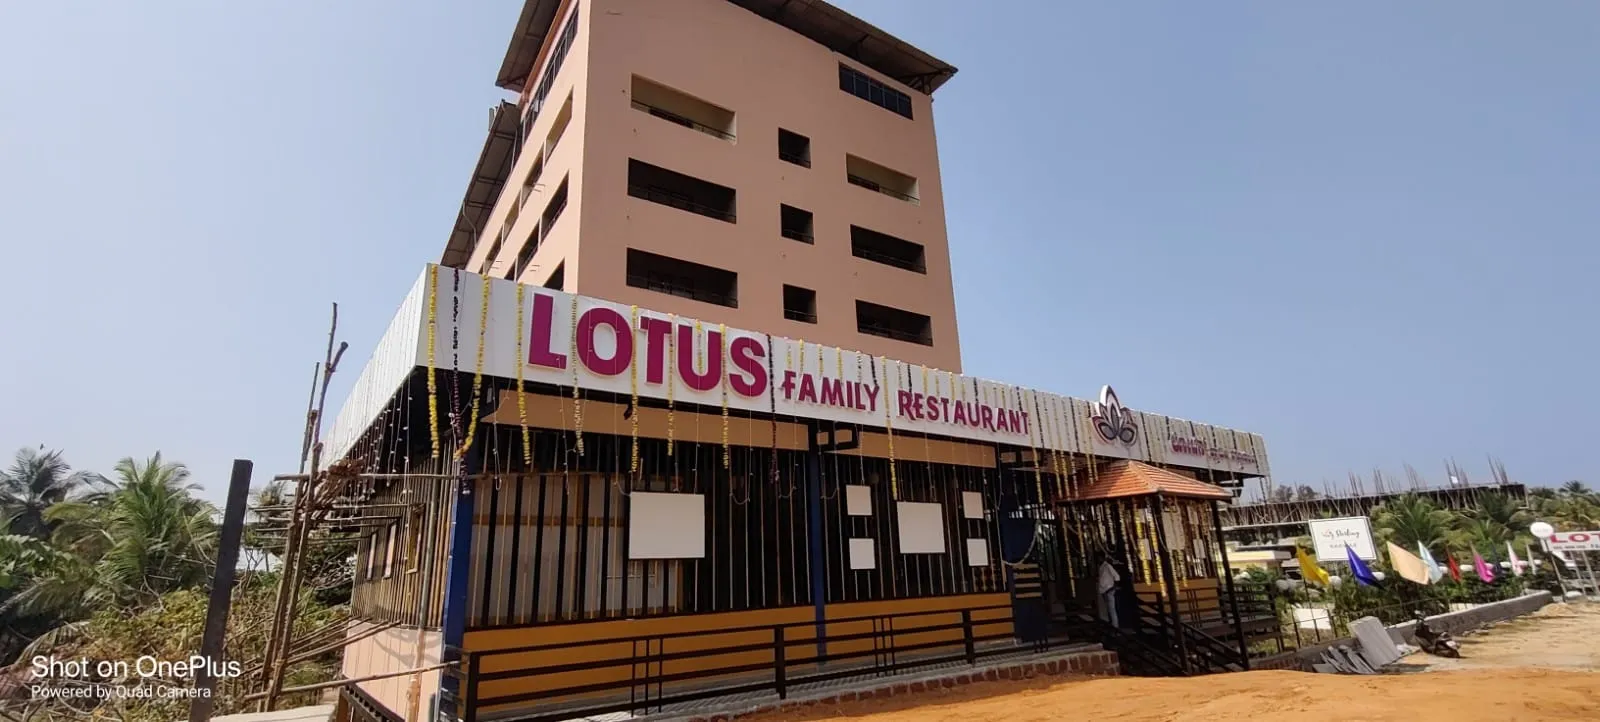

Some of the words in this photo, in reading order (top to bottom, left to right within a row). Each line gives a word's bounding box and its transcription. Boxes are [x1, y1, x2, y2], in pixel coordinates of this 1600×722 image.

[527, 292, 768, 398] LOTUS
[781, 370, 880, 412] FAMILY
[898, 390, 1029, 434] RESTAURANT
